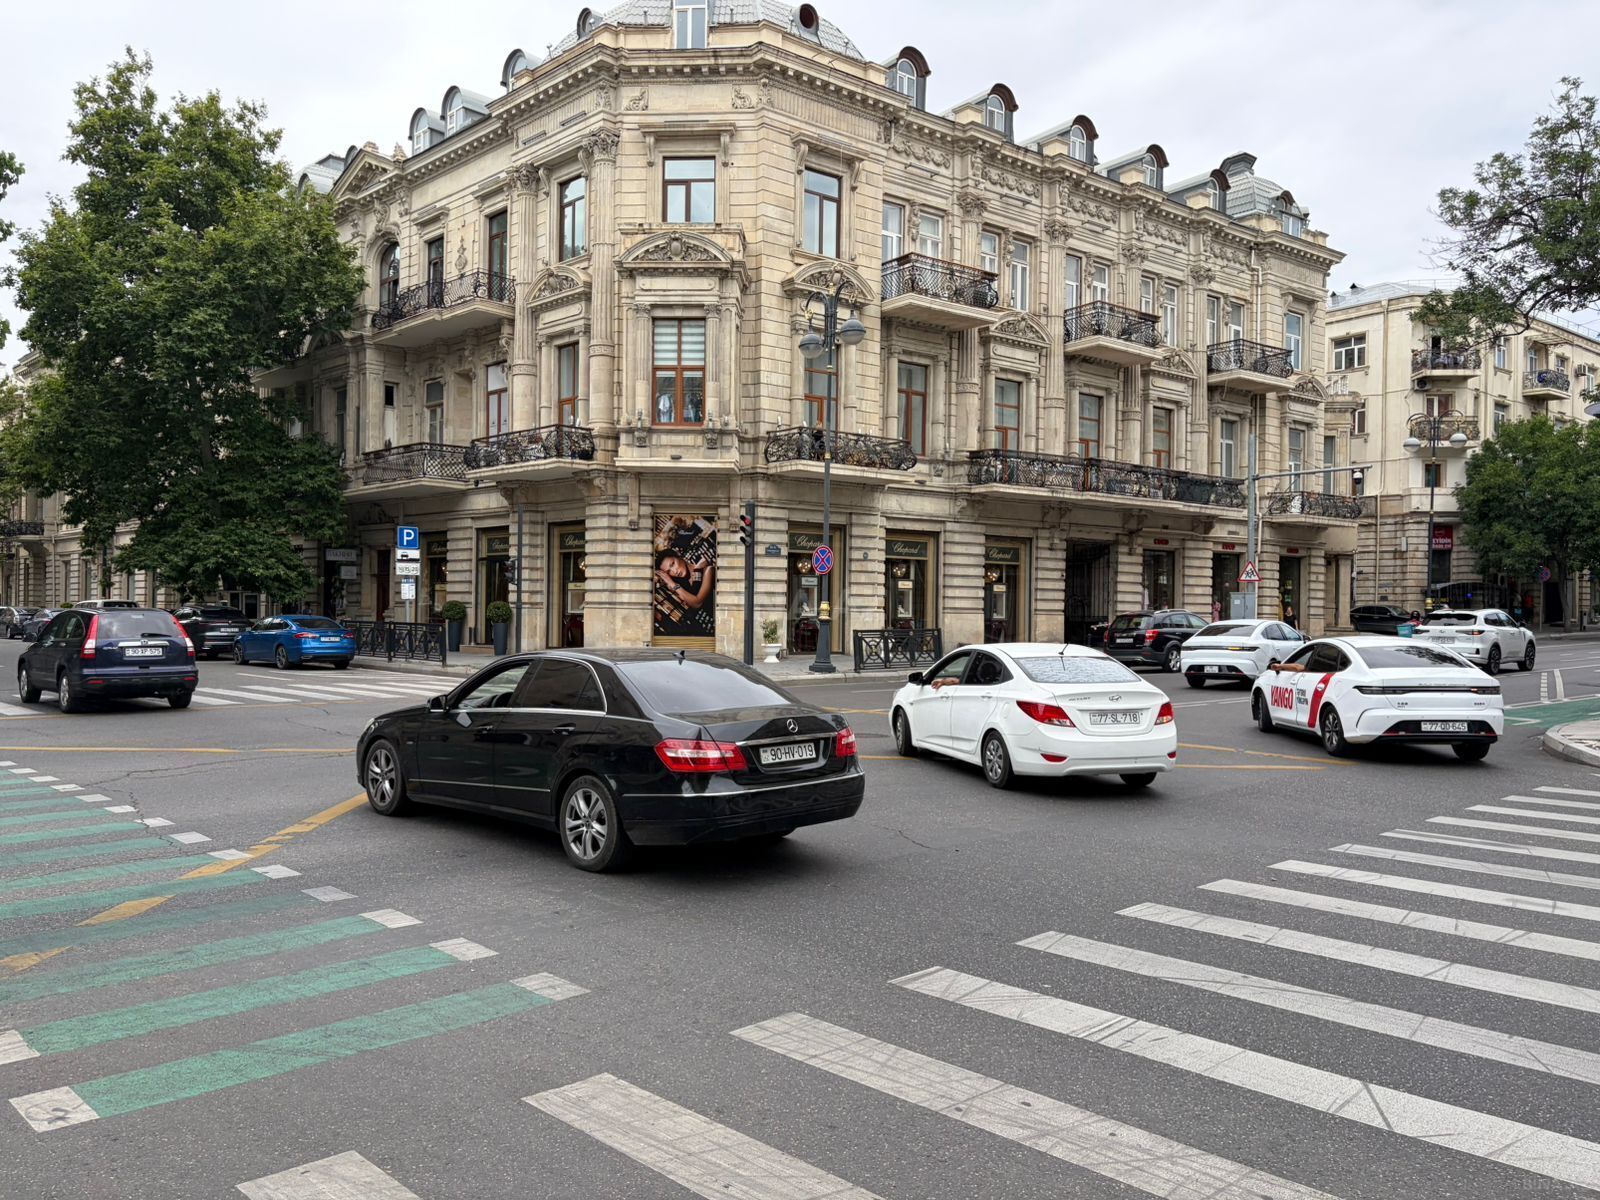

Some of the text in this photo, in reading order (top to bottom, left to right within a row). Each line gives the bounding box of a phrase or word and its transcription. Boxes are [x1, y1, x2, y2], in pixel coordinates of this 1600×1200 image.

[403, 529, 415, 546] P
[892, 542, 920, 555] Chopard
[1271, 685, 1293, 710] YANGO
[1098, 712, 1138, 723] 77-SL-718
[770, 744, 814, 761] 90-HV-019
